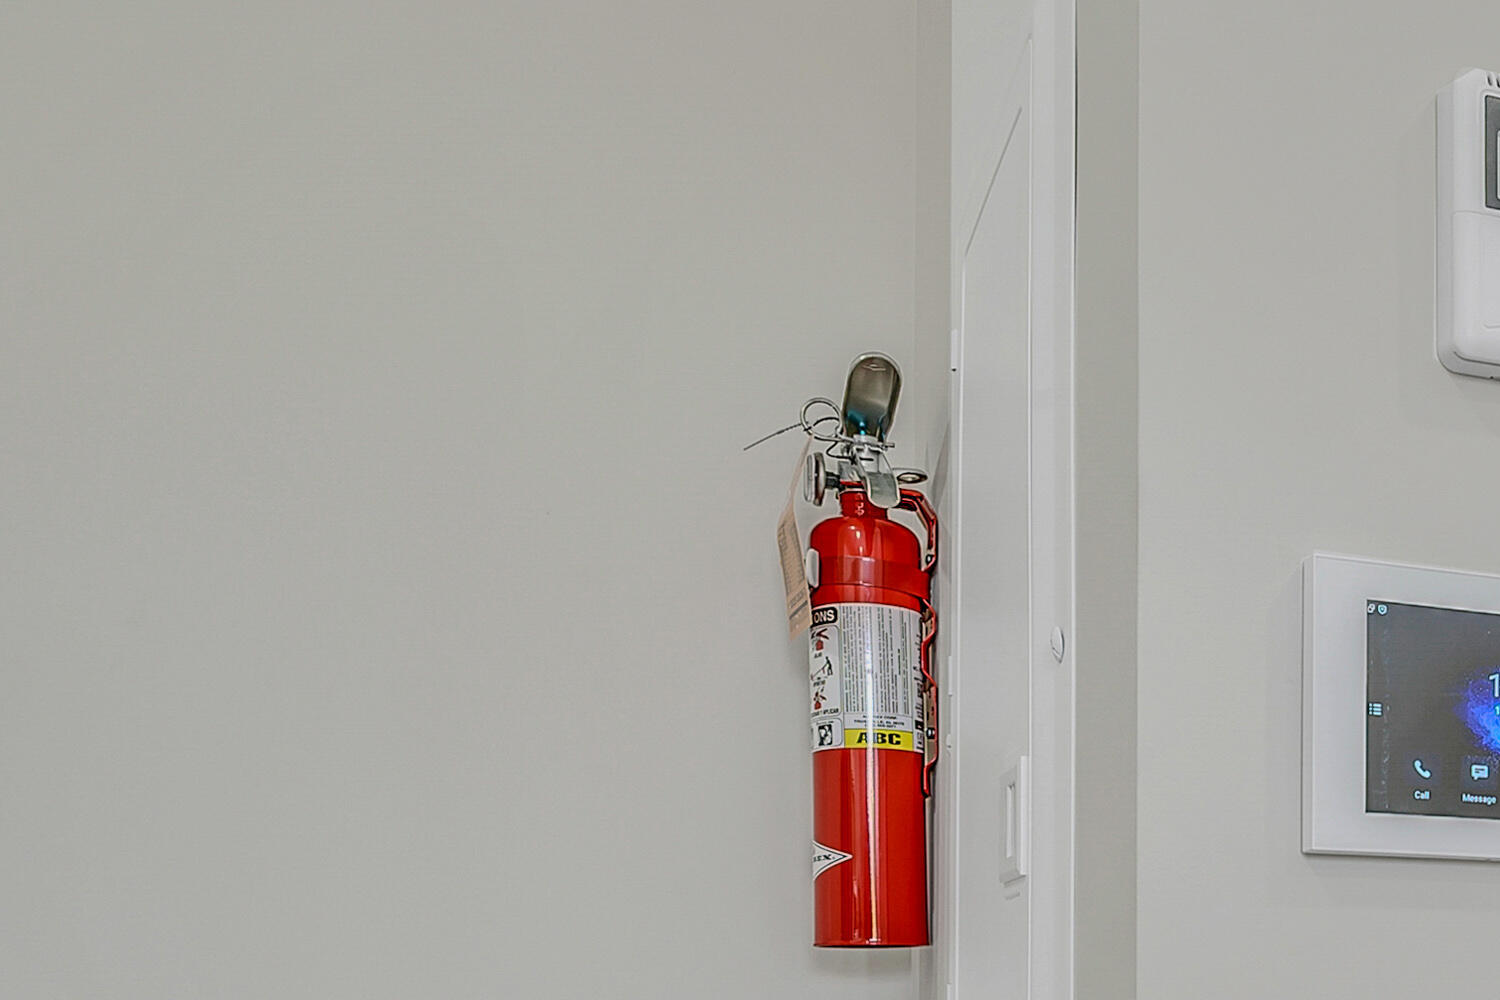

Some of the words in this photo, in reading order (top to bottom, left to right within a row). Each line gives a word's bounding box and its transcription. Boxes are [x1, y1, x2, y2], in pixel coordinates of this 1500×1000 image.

[856, 731, 902, 746] ABC
[1413, 790, 1430, 800] Call
[1462, 793, 1497, 805] Message
